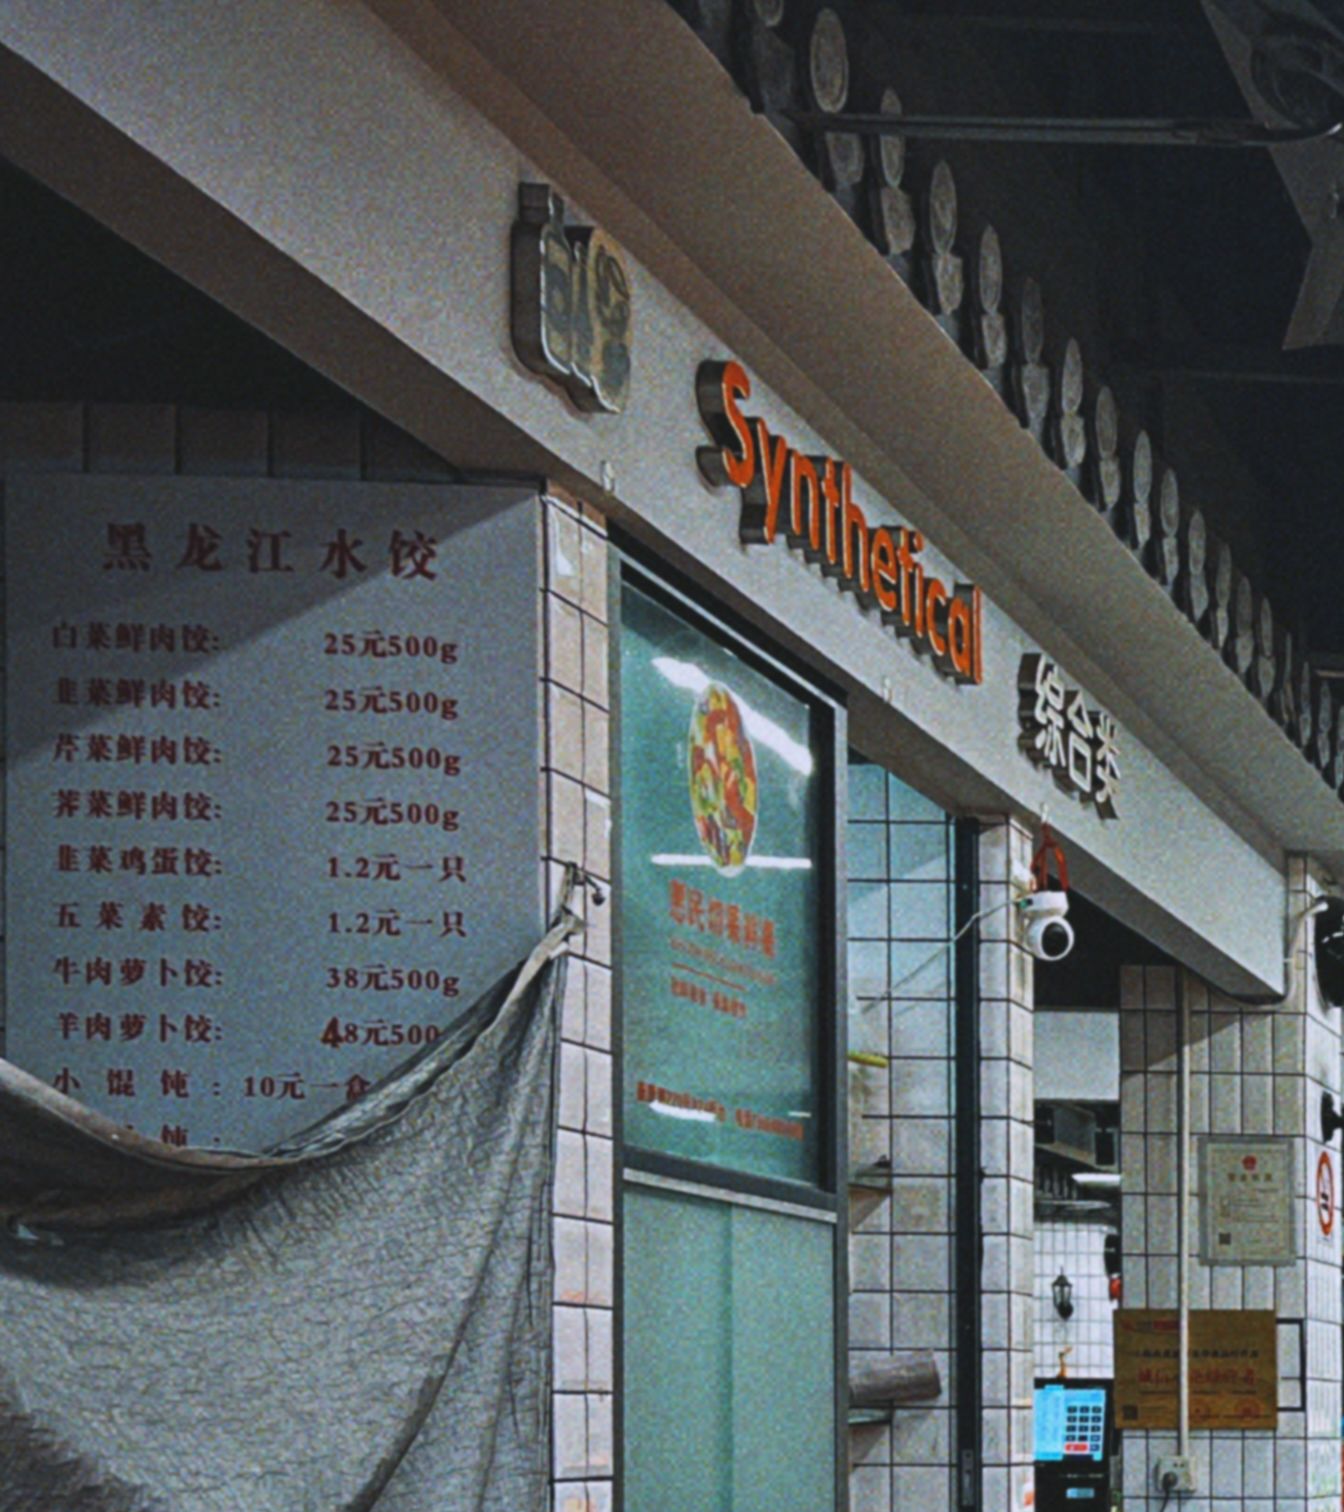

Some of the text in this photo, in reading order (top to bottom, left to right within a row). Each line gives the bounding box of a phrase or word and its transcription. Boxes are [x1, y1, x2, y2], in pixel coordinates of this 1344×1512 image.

[721, 360, 983, 685] Synthetical
[102, 522, 439, 581] 黑龙江水饺
[323, 632, 458, 663] 25元500g
[324, 687, 458, 719] 25元500g
[327, 743, 461, 776] 25元500g
[325, 799, 459, 831] 25元500g
[326, 964, 460, 997] 38元500g
